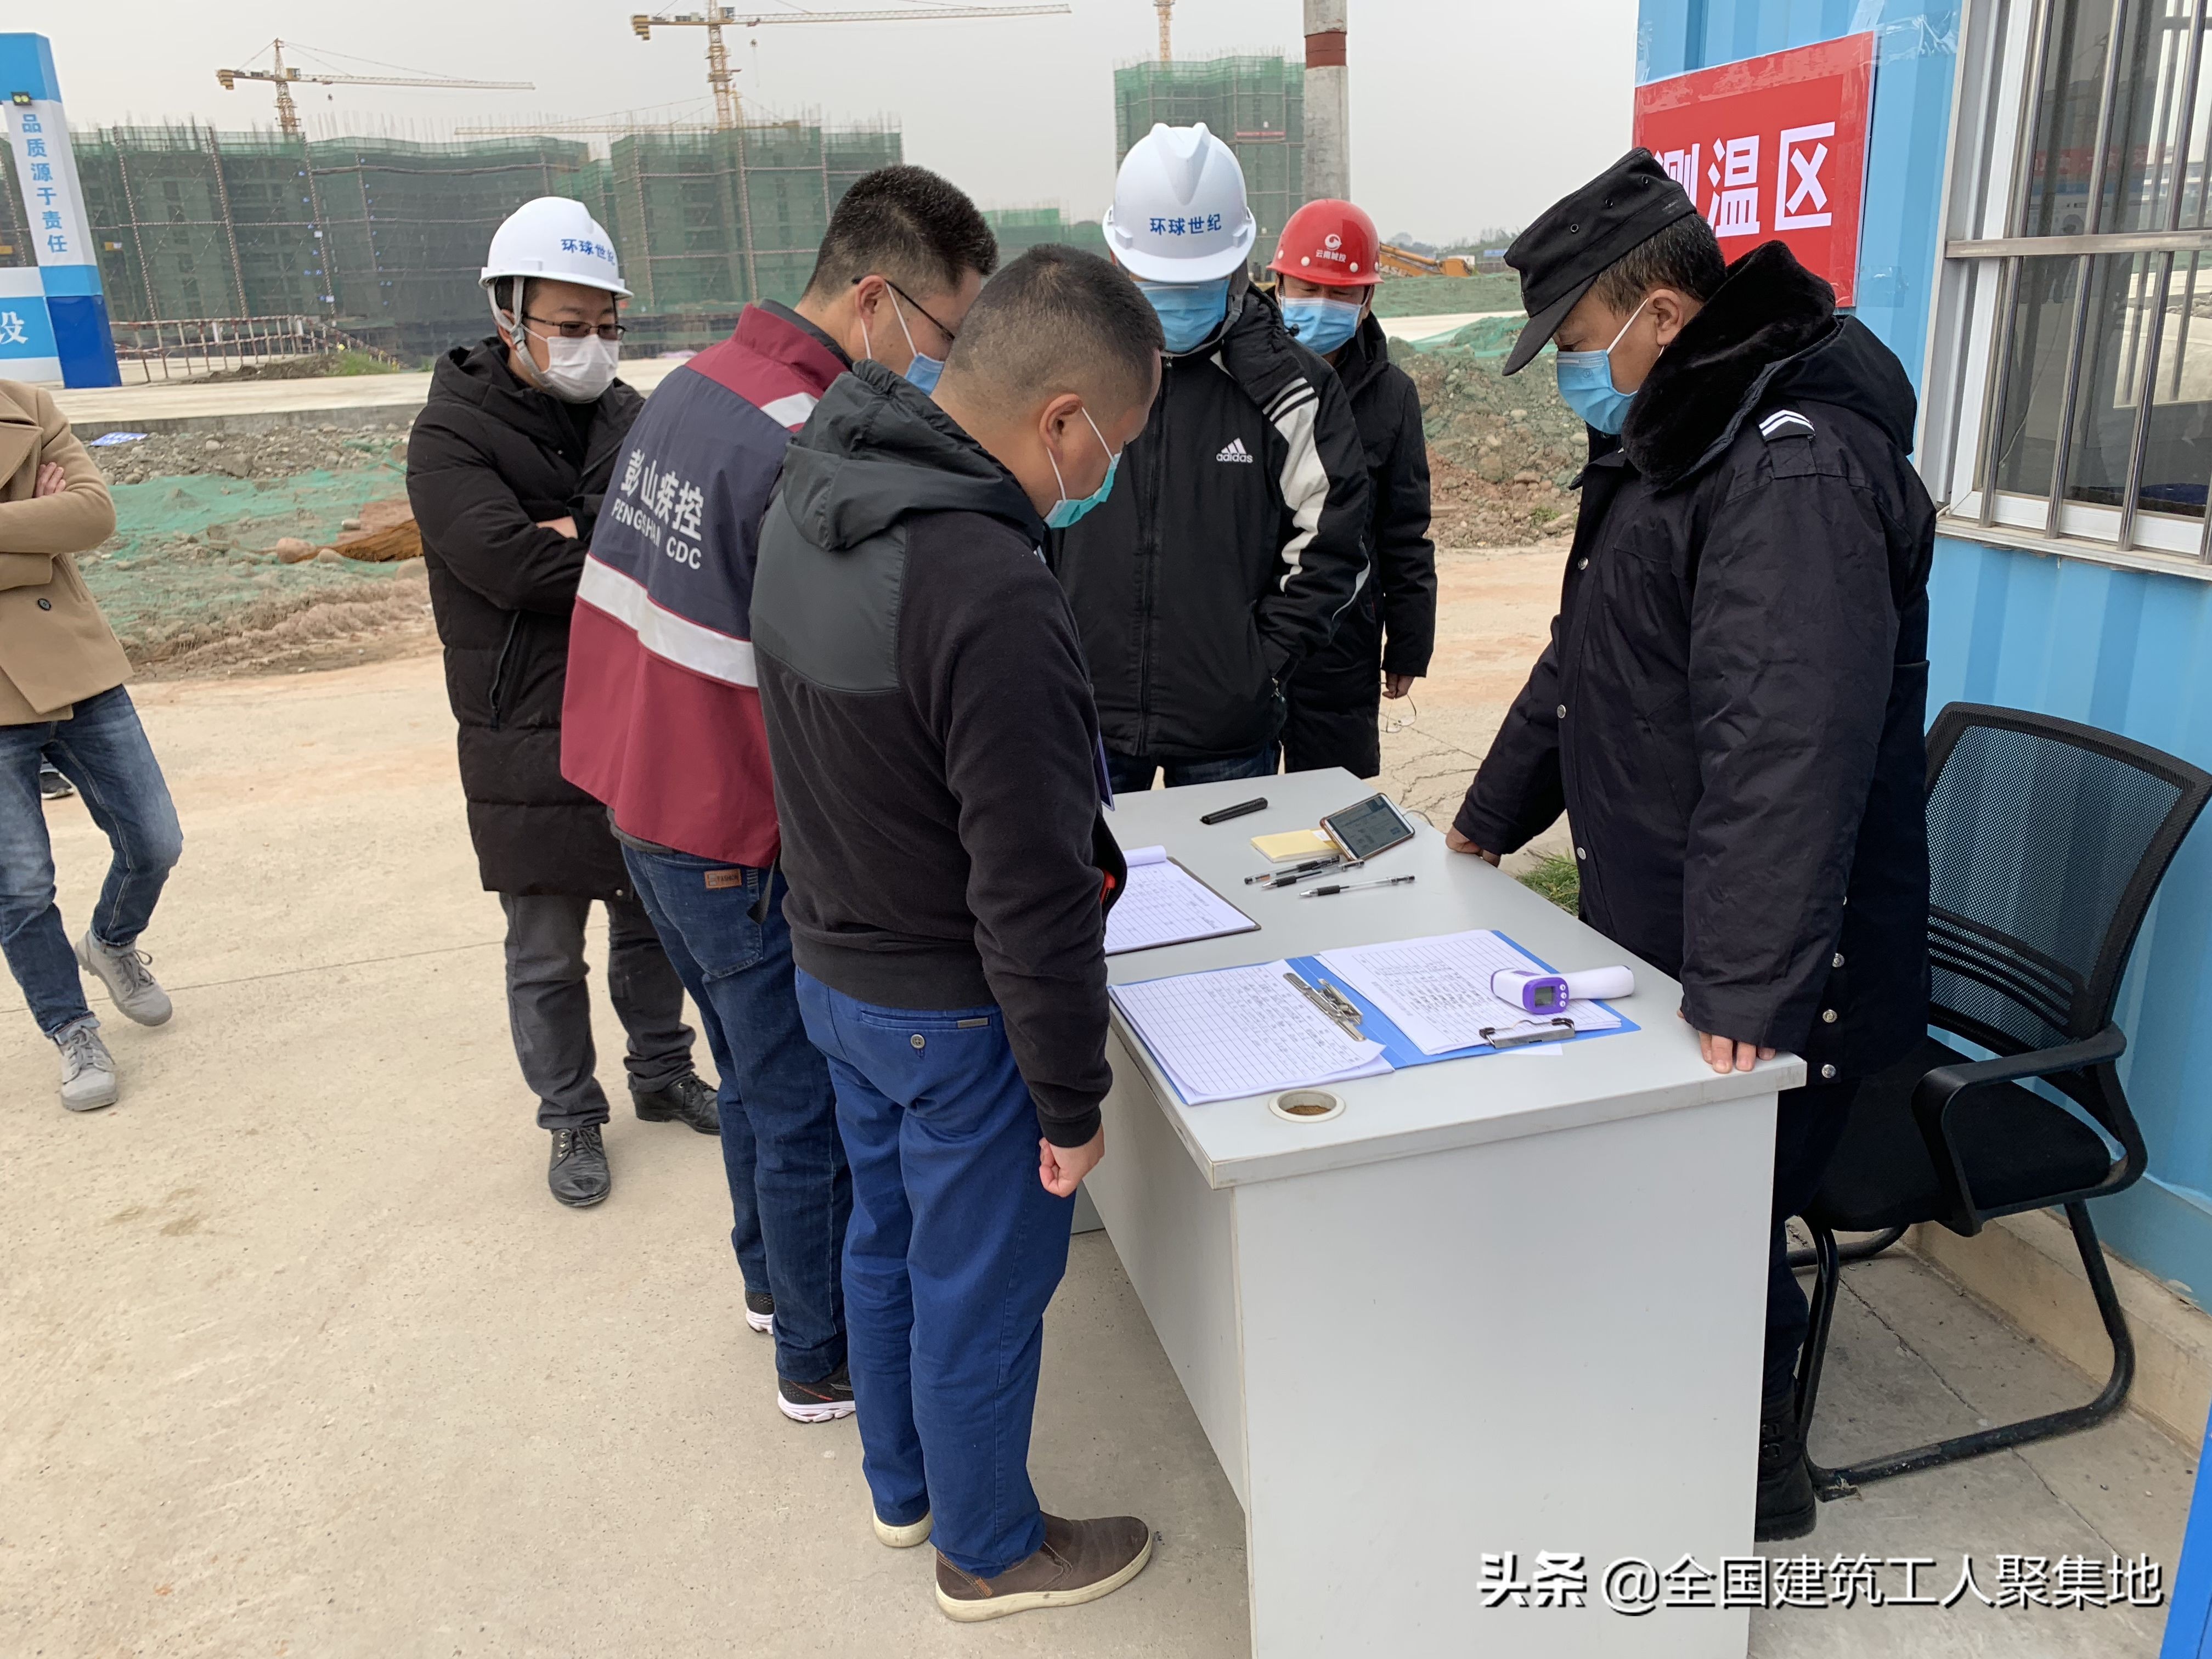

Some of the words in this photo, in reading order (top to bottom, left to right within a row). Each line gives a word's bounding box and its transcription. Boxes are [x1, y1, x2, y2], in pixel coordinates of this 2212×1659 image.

[21, 114, 67, 253] 品质源于责任
[1150, 213, 1221, 235] 环球世纪
[560, 239, 615, 266] 环球世纪
[1216, 453, 1253, 463] adidas
[620, 448, 704, 541] 彭山疾控
[666, 535, 702, 569] CDC
